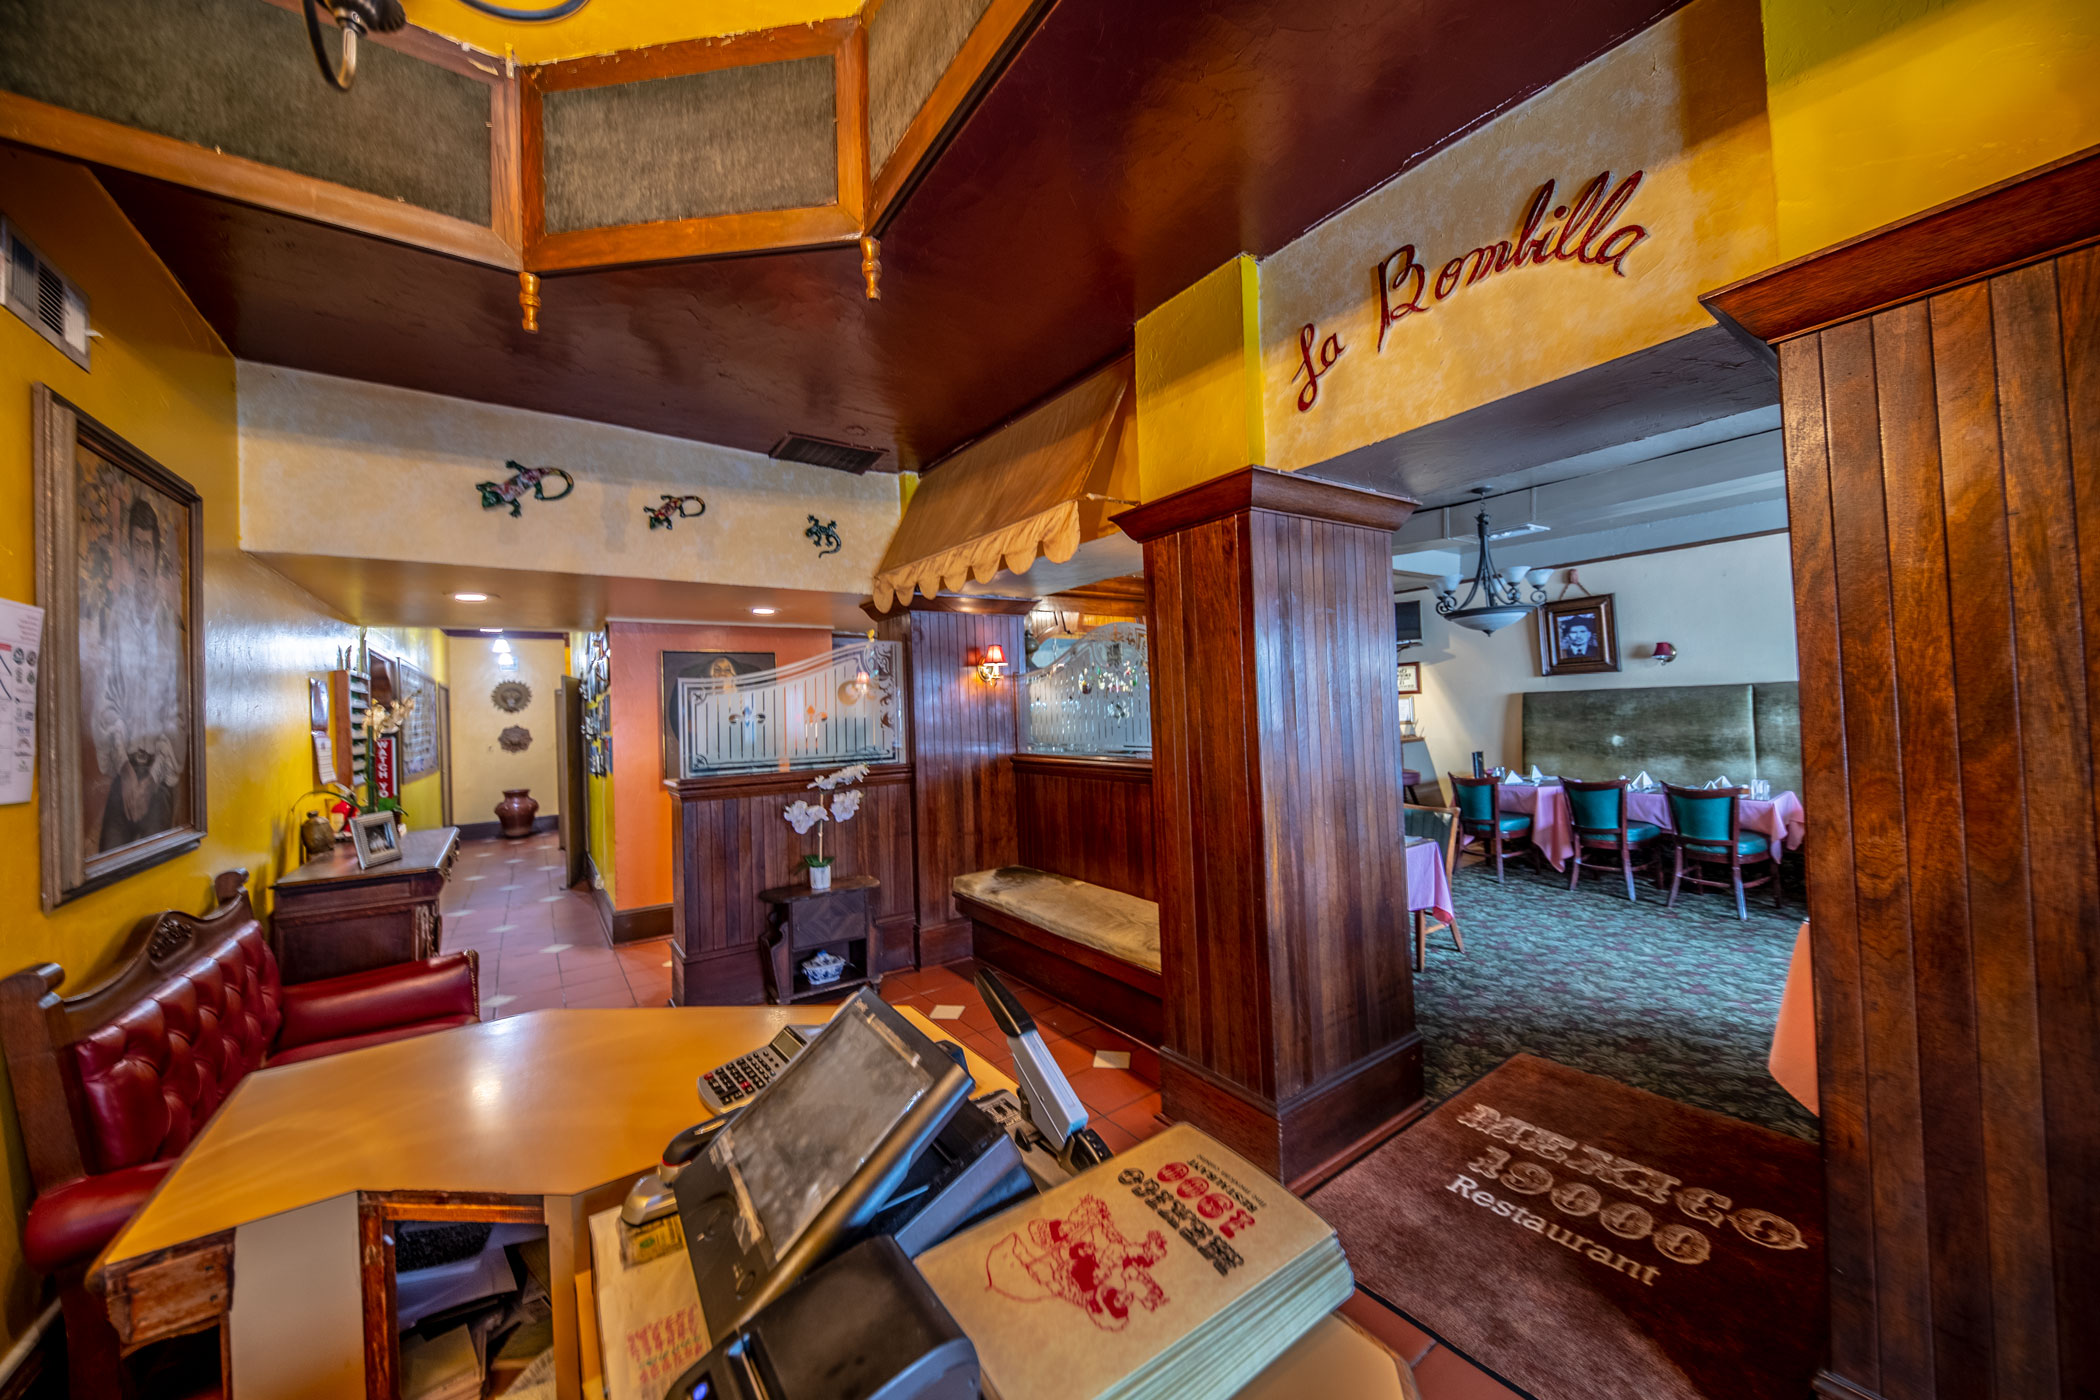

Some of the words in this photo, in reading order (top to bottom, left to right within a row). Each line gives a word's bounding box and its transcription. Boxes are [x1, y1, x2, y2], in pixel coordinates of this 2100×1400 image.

[1292, 322, 1346, 412] La
[1376, 170, 1650, 354] Bombilla
[376, 740, 389, 779] WATCH
[1117, 1167, 1245, 1278] MEXICO
[1445, 1174, 1662, 1287] Restaurant
[1456, 1103, 1809, 1251] MEXICO
